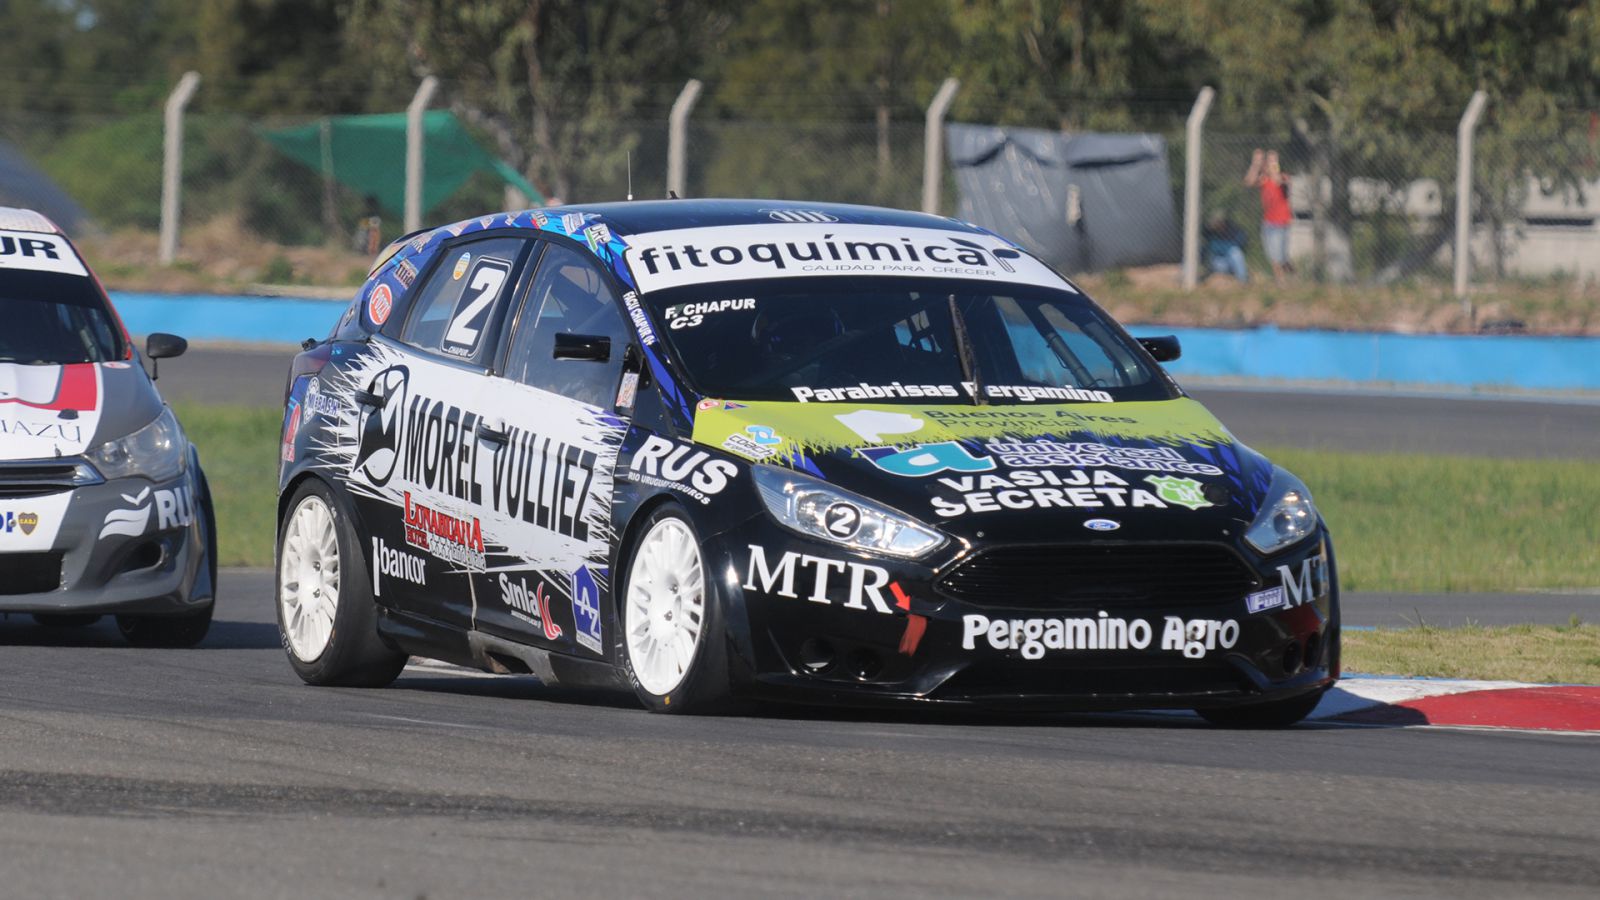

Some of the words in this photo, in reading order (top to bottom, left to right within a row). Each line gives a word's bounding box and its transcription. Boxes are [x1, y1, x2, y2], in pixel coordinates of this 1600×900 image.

[639, 233, 989, 275] fitoquímica
[801, 263, 875, 272] CALIDAD
[881, 263, 925, 273] PARA
[931, 264, 996, 277] CRECER
[446, 266, 506, 346] 2
[623, 291, 640, 311] FACU
[683, 298, 756, 316] CHAPUR
[630, 308, 652, 339] CHAPUR
[670, 315, 704, 330] C3
[791, 380, 958, 402] Parabrisas
[922, 410, 1046, 419] Buenos
[1056, 410, 1139, 424] Aires
[937, 418, 1080, 428] Provincia
[630, 434, 739, 495] RUS
[984, 440, 1186, 462] universal
[1004, 452, 1223, 476] assistance
[403, 392, 484, 506] MOREL
[491, 425, 598, 543] VULLIEZ
[938, 470, 1130, 493] VASIJA
[628, 471, 641, 482] RIO
[668, 481, 711, 505] SEGUROS
[930, 487, 1168, 517] SECRETA
[153, 487, 194, 530] RU
[832, 507, 857, 535] 2
[379, 538, 426, 586] bancor
[743, 544, 894, 615] MTR
[574, 575, 601, 640] LAZ
[961, 610, 1152, 660] Pergamino
[1161, 615, 1240, 659] Agro
